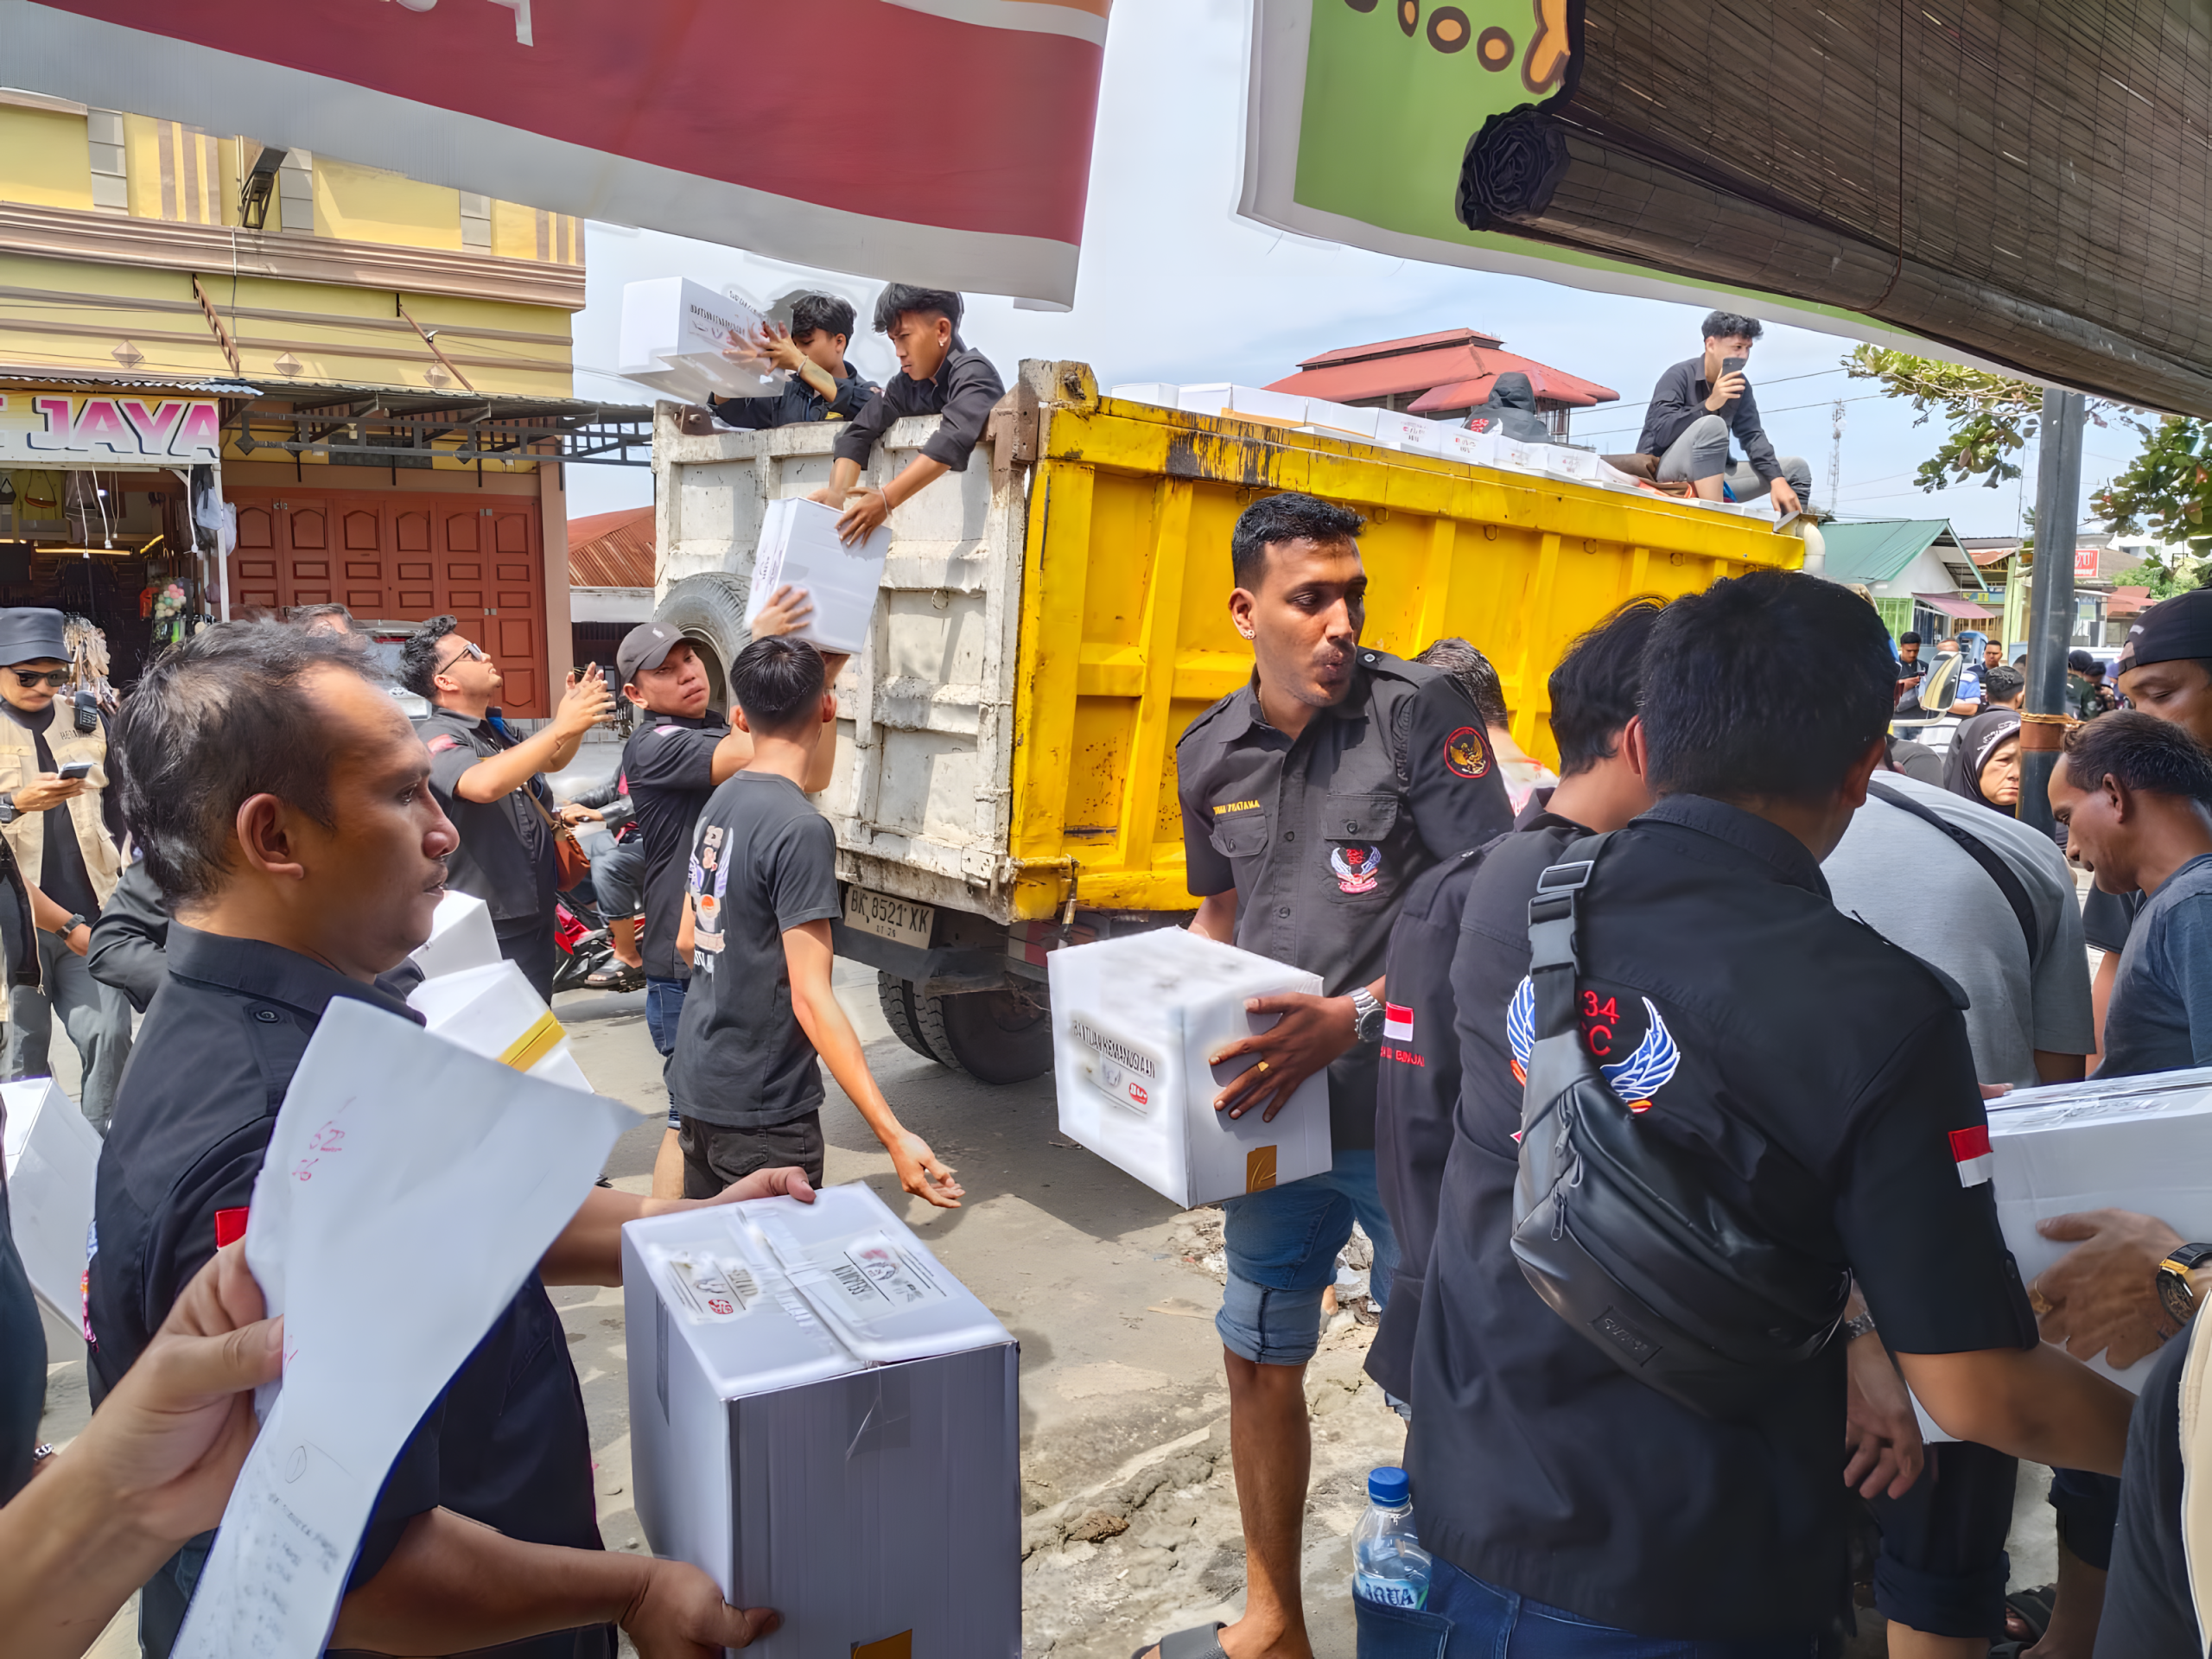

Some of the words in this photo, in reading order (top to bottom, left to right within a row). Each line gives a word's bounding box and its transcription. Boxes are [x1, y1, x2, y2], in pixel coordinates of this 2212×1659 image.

[29, 396, 219, 456] JAYA
[850, 889, 868, 916] BK
[871, 897, 903, 927] 8521
[909, 906, 930, 933] XK
[1580, 990, 1620, 1025] 34
[1581, 1021, 1612, 1056] C
[1364, 1582, 1414, 1606] AQUA
